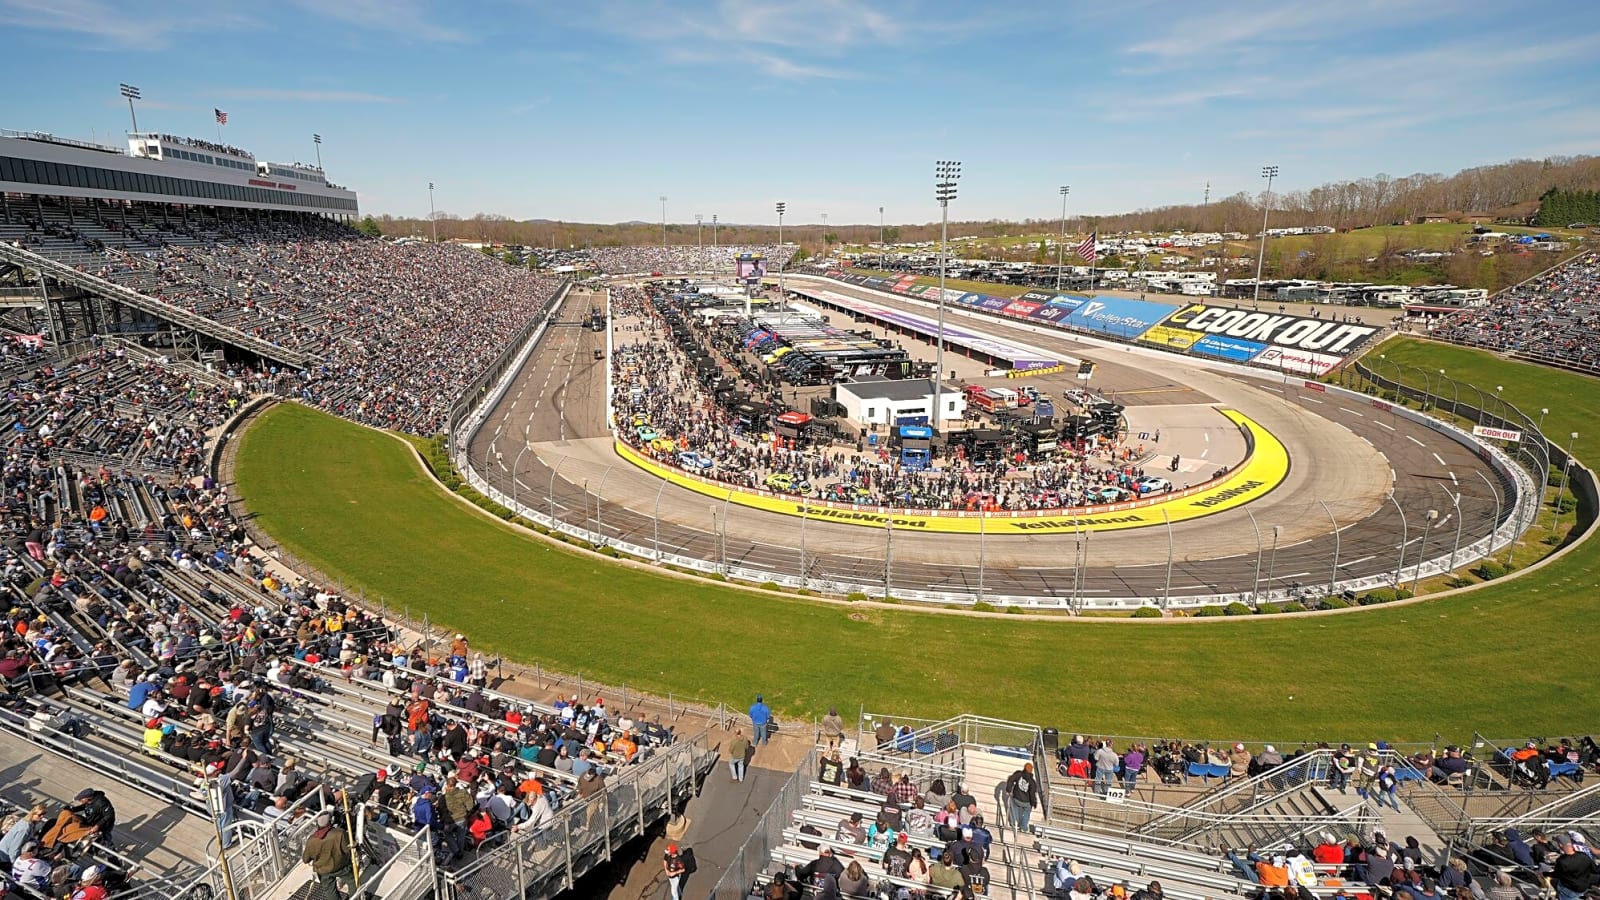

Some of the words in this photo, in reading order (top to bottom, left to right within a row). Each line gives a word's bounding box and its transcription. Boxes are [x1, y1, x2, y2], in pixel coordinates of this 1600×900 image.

[1186, 308, 1297, 340] COOK
[1274, 320, 1377, 353] OUT
[1481, 429, 1502, 437] COOK
[1502, 431, 1518, 439] OUT
[1189, 480, 1265, 508] YellaWood
[796, 505, 927, 528] YellaWood
[1011, 515, 1145, 530] YellaWood
